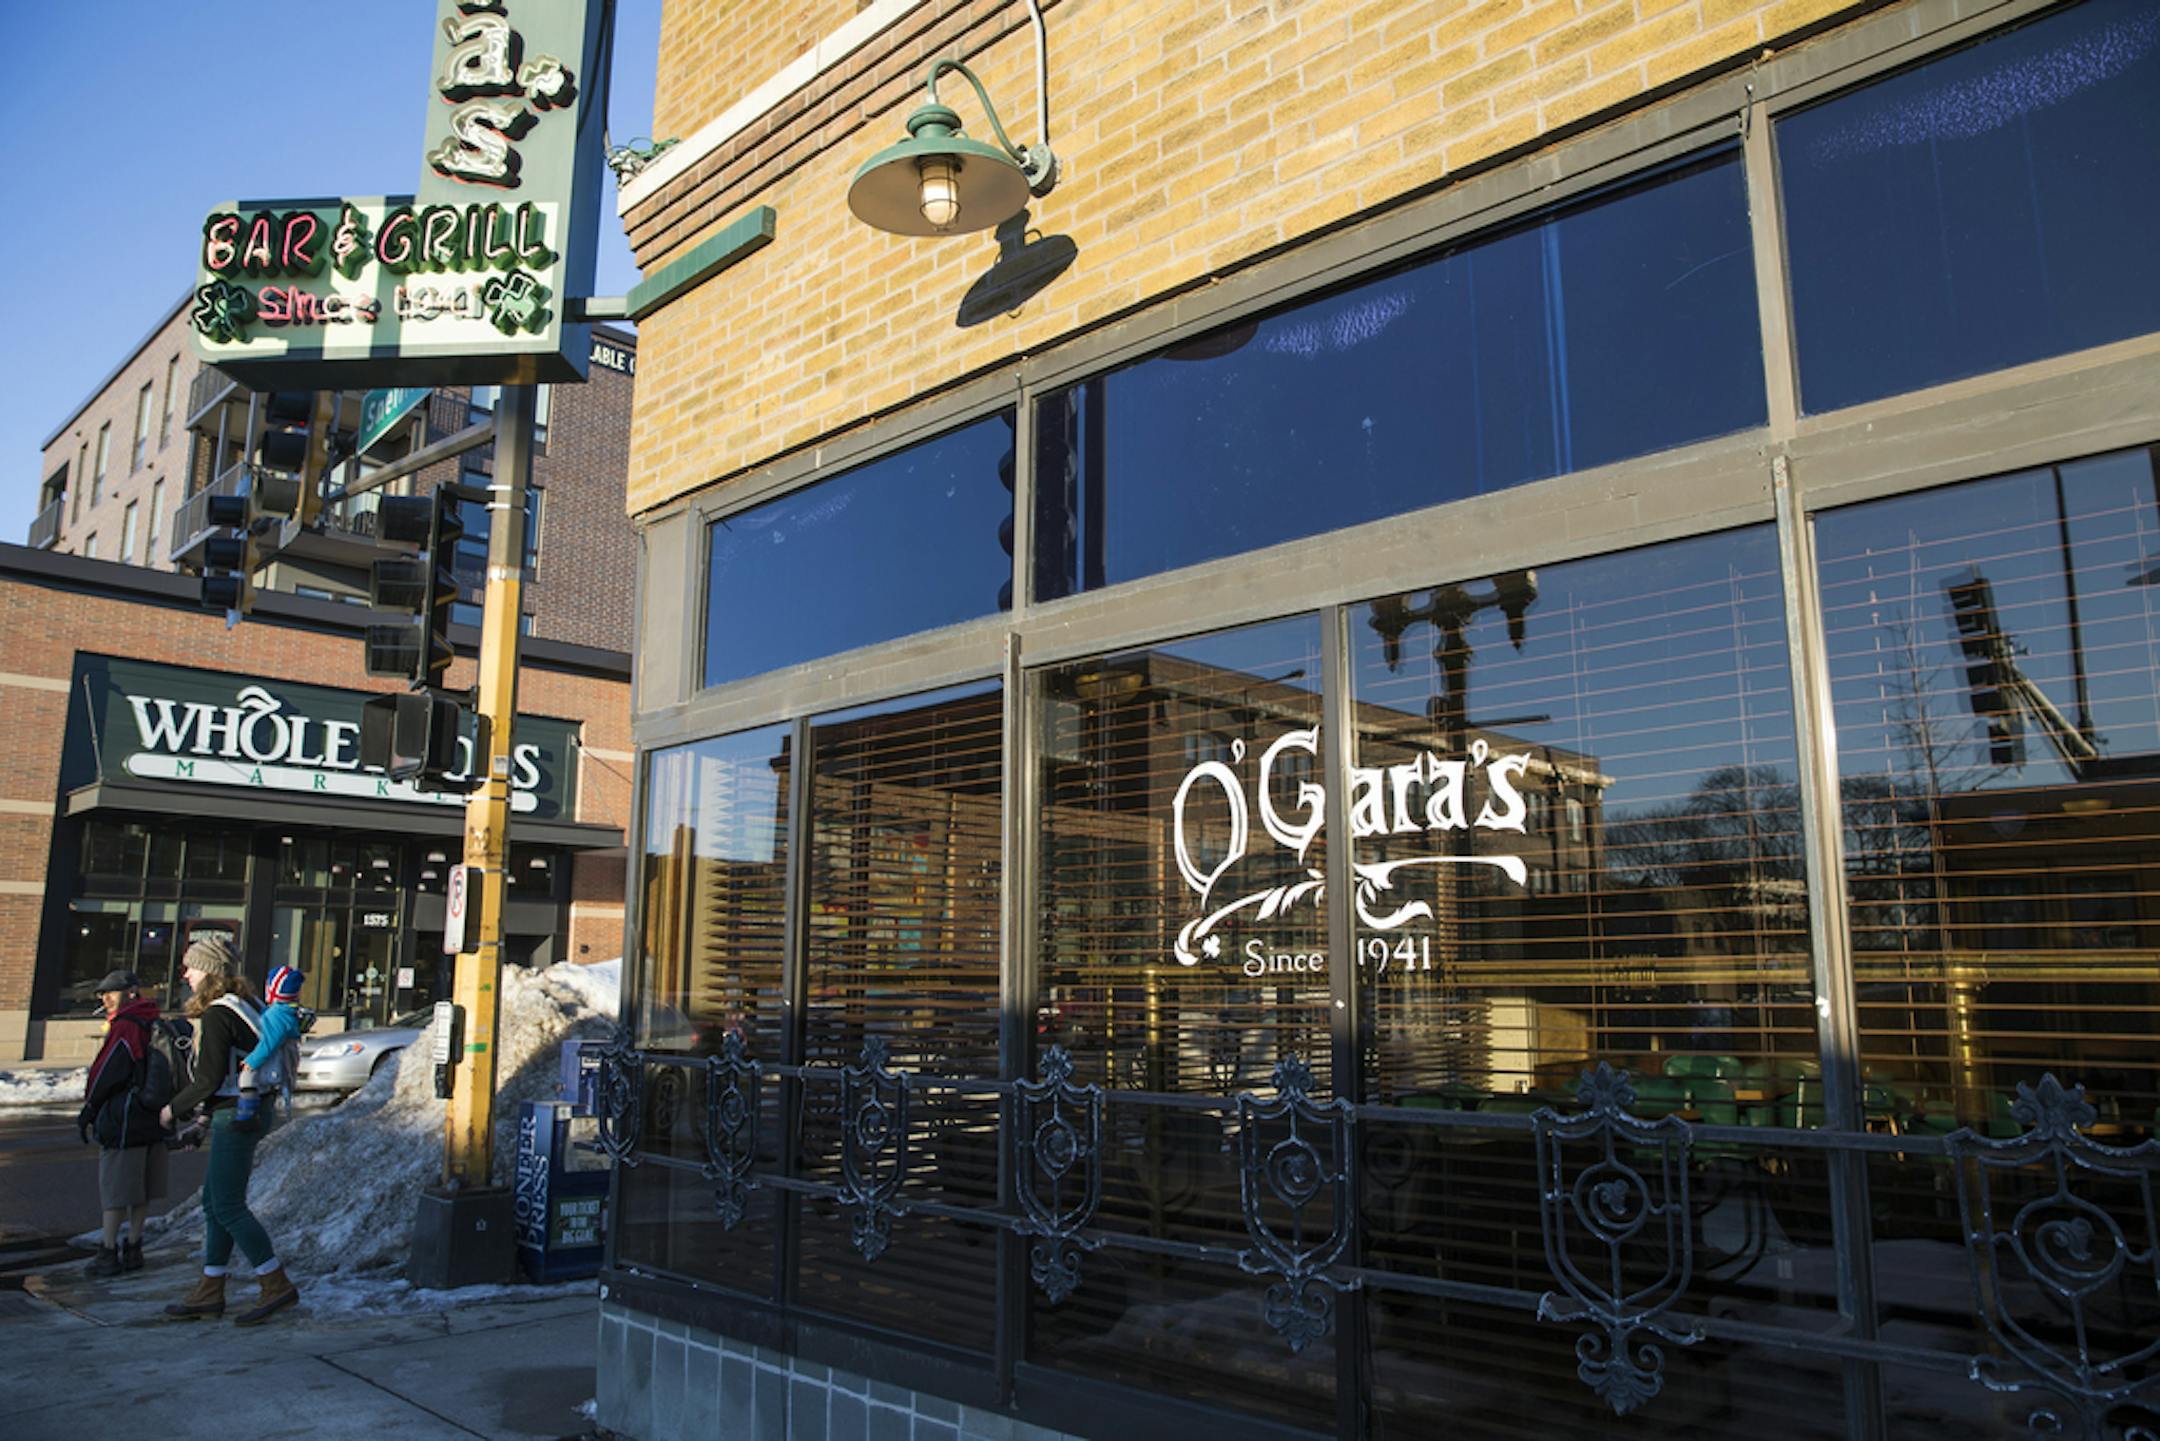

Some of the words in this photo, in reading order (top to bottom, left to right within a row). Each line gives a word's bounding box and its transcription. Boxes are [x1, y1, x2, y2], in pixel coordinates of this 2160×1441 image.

[204, 211, 324, 276] BAR
[332, 203, 371, 275] &
[376, 203, 551, 272] GRILL
[589, 344, 626, 371] ABLE
[126, 694, 361, 770] WHOLE
[1172, 725, 1532, 909] O'Gara's
[1243, 938, 1324, 977] Since
[1357, 935, 1431, 974] 1941
[515, 1114, 537, 1248] PIONEER
[526, 1154, 550, 1253] PRESS
